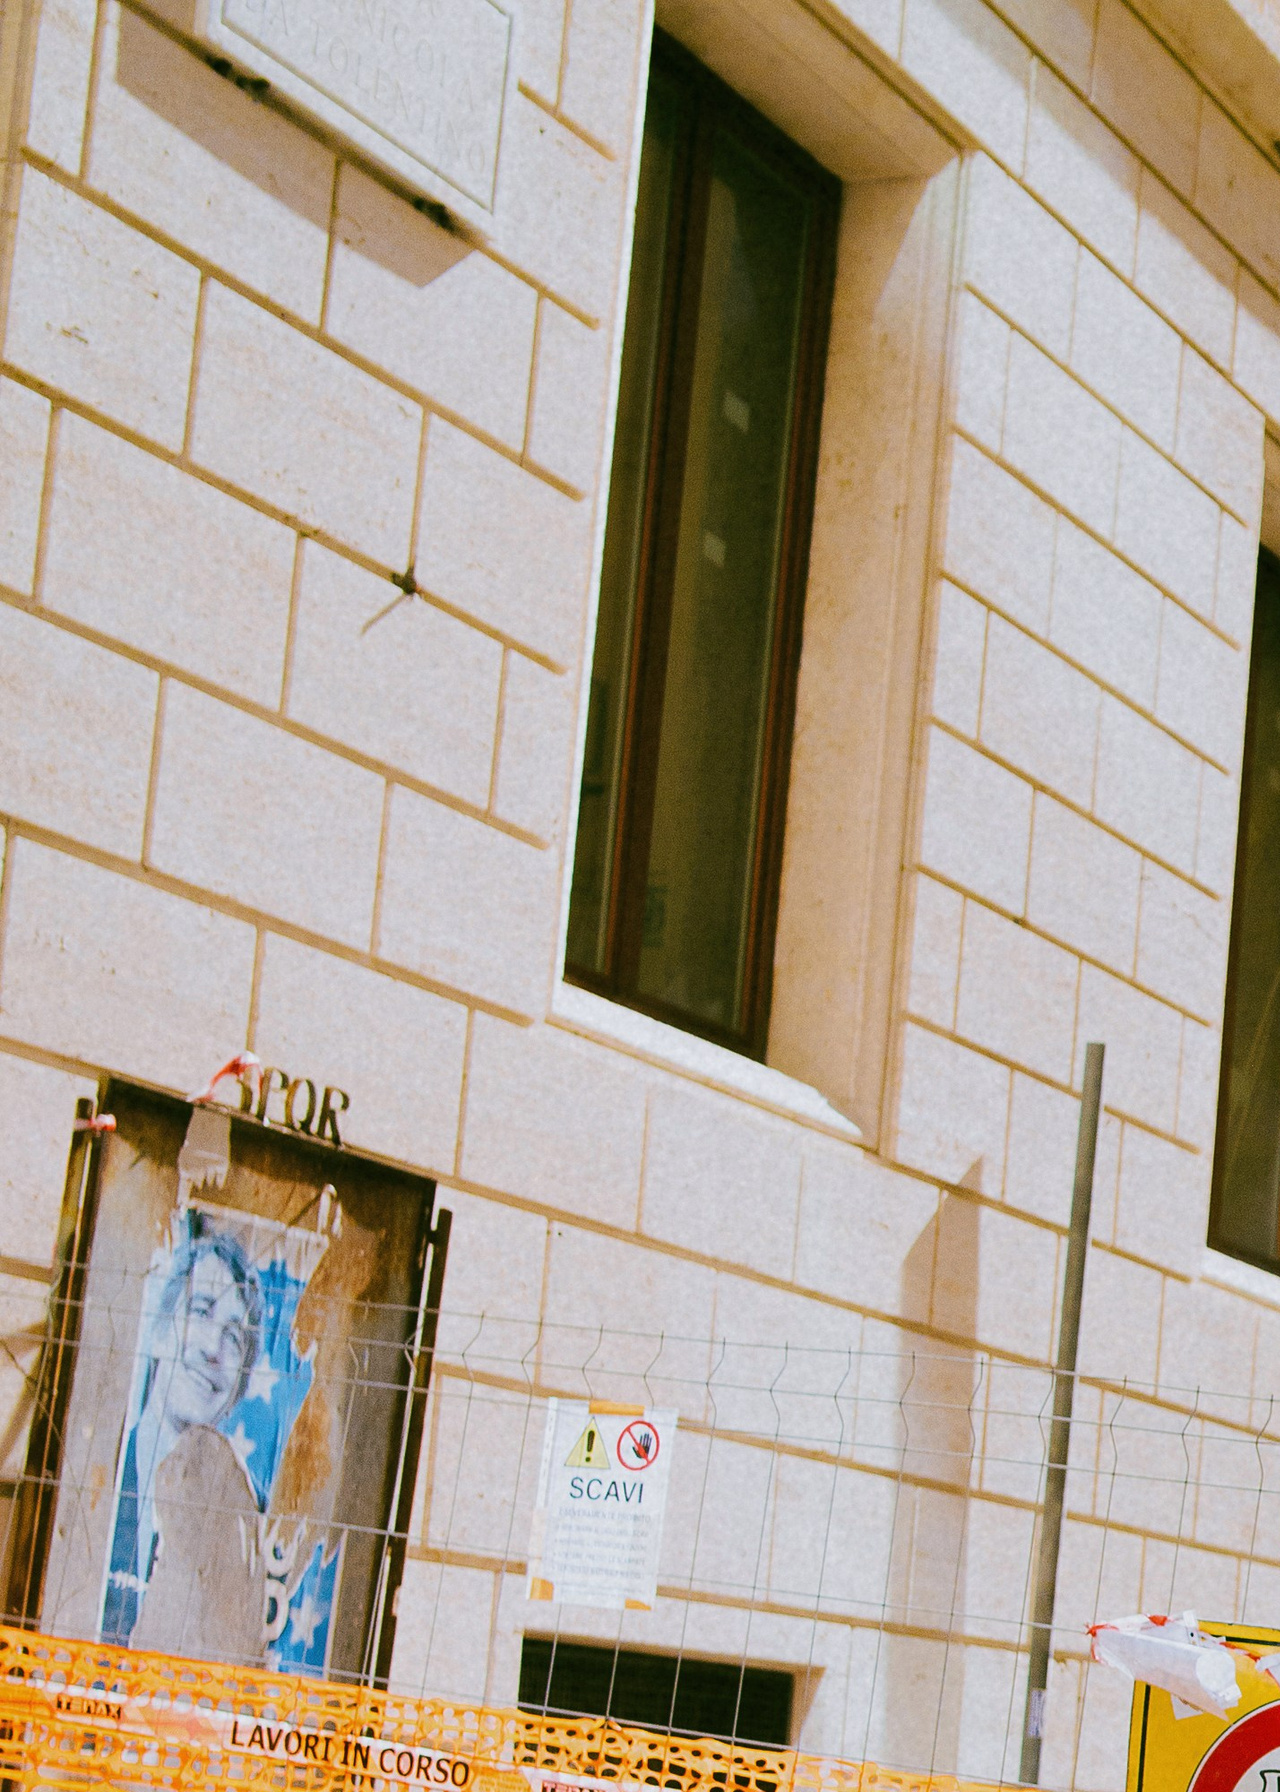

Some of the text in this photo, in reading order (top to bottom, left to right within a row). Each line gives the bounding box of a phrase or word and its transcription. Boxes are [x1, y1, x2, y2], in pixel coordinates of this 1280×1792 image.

[569, 1476, 644, 1504] SCAVI
[230, 1720, 331, 1763] LAVORI
[341, 1742, 371, 1771] IN
[379, 1747, 470, 1788] CORSO
